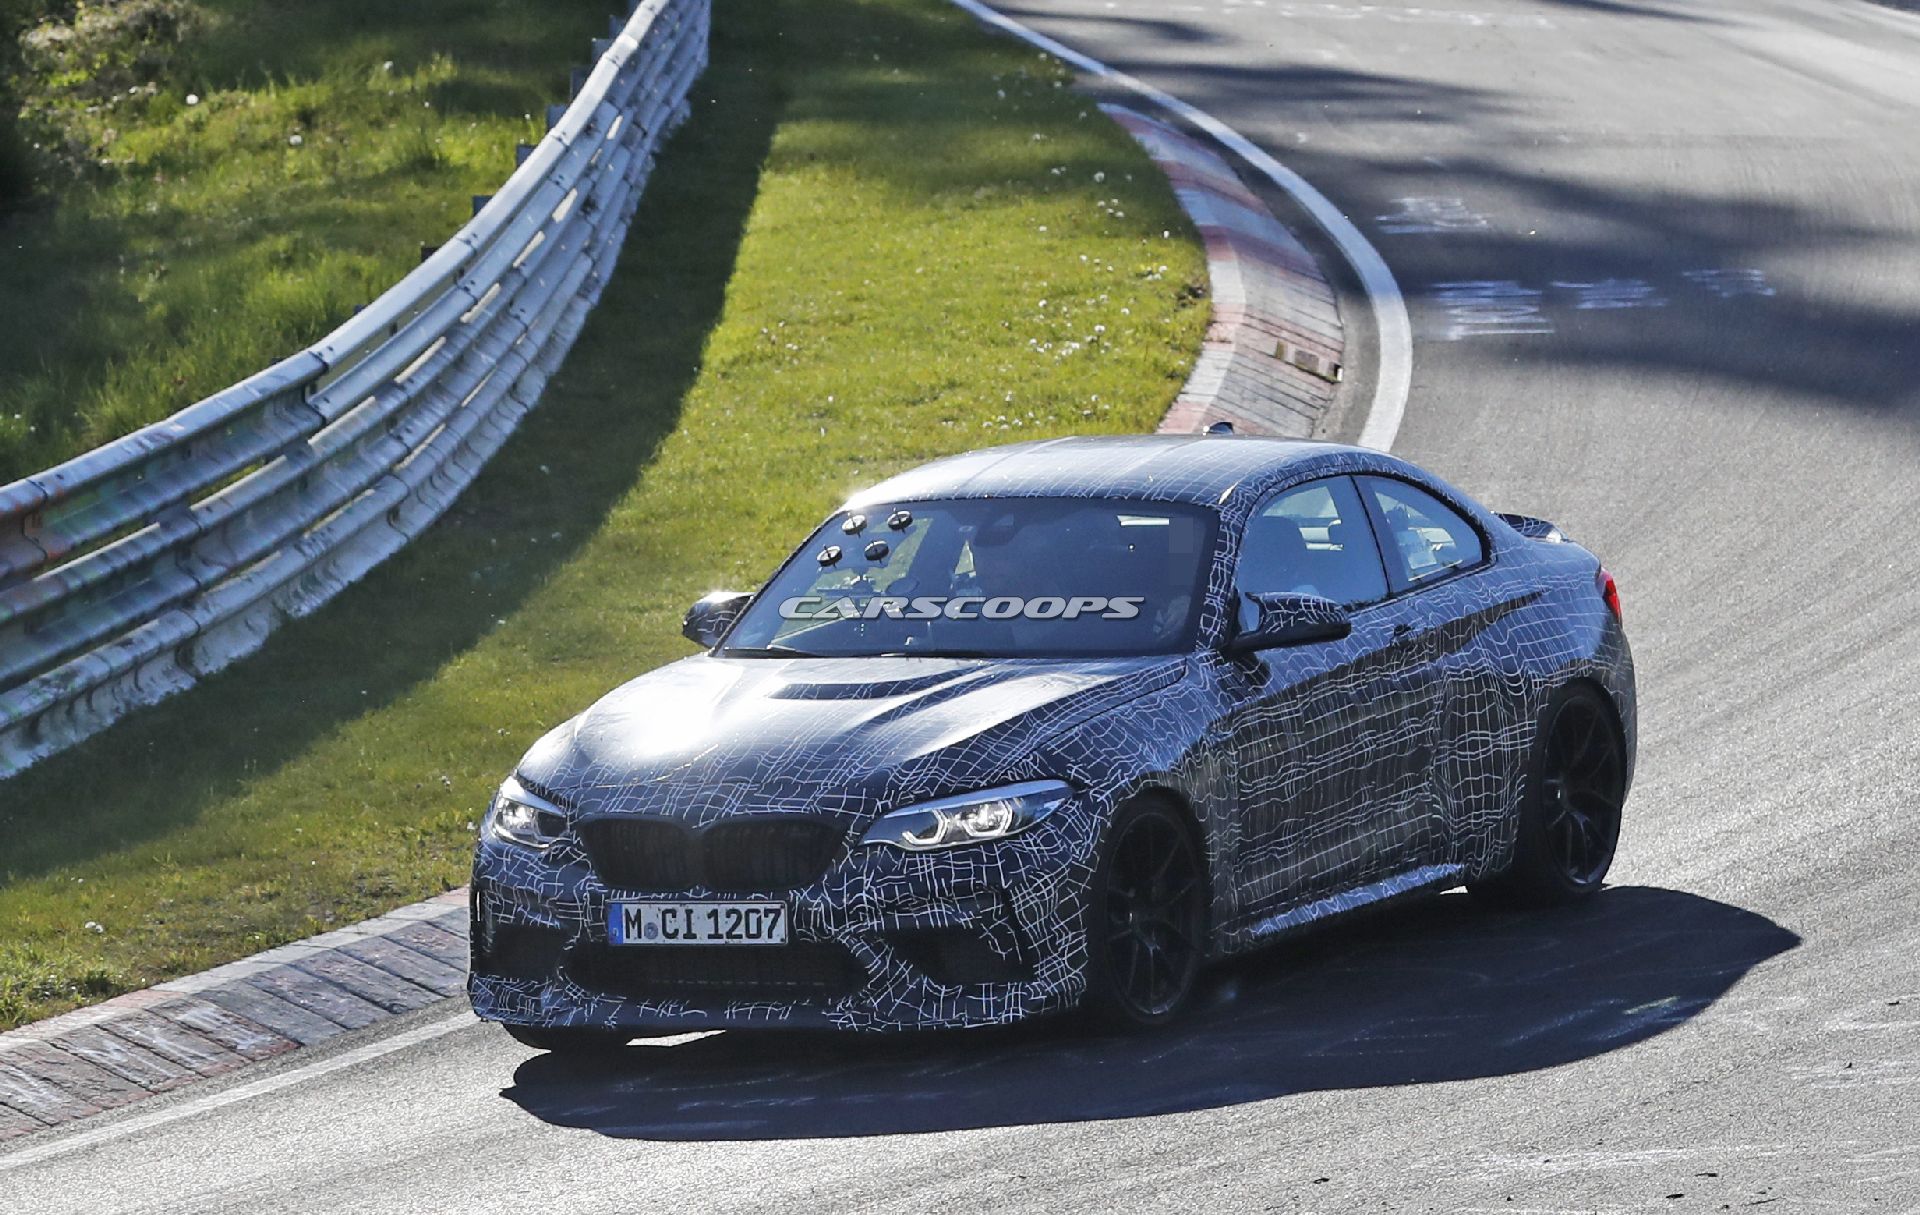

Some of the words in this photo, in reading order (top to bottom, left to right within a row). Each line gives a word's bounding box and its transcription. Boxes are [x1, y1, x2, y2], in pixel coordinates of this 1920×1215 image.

[624, 908, 642, 939] M
[661, 908, 698, 940] CI
[707, 908, 782, 940] 1207
